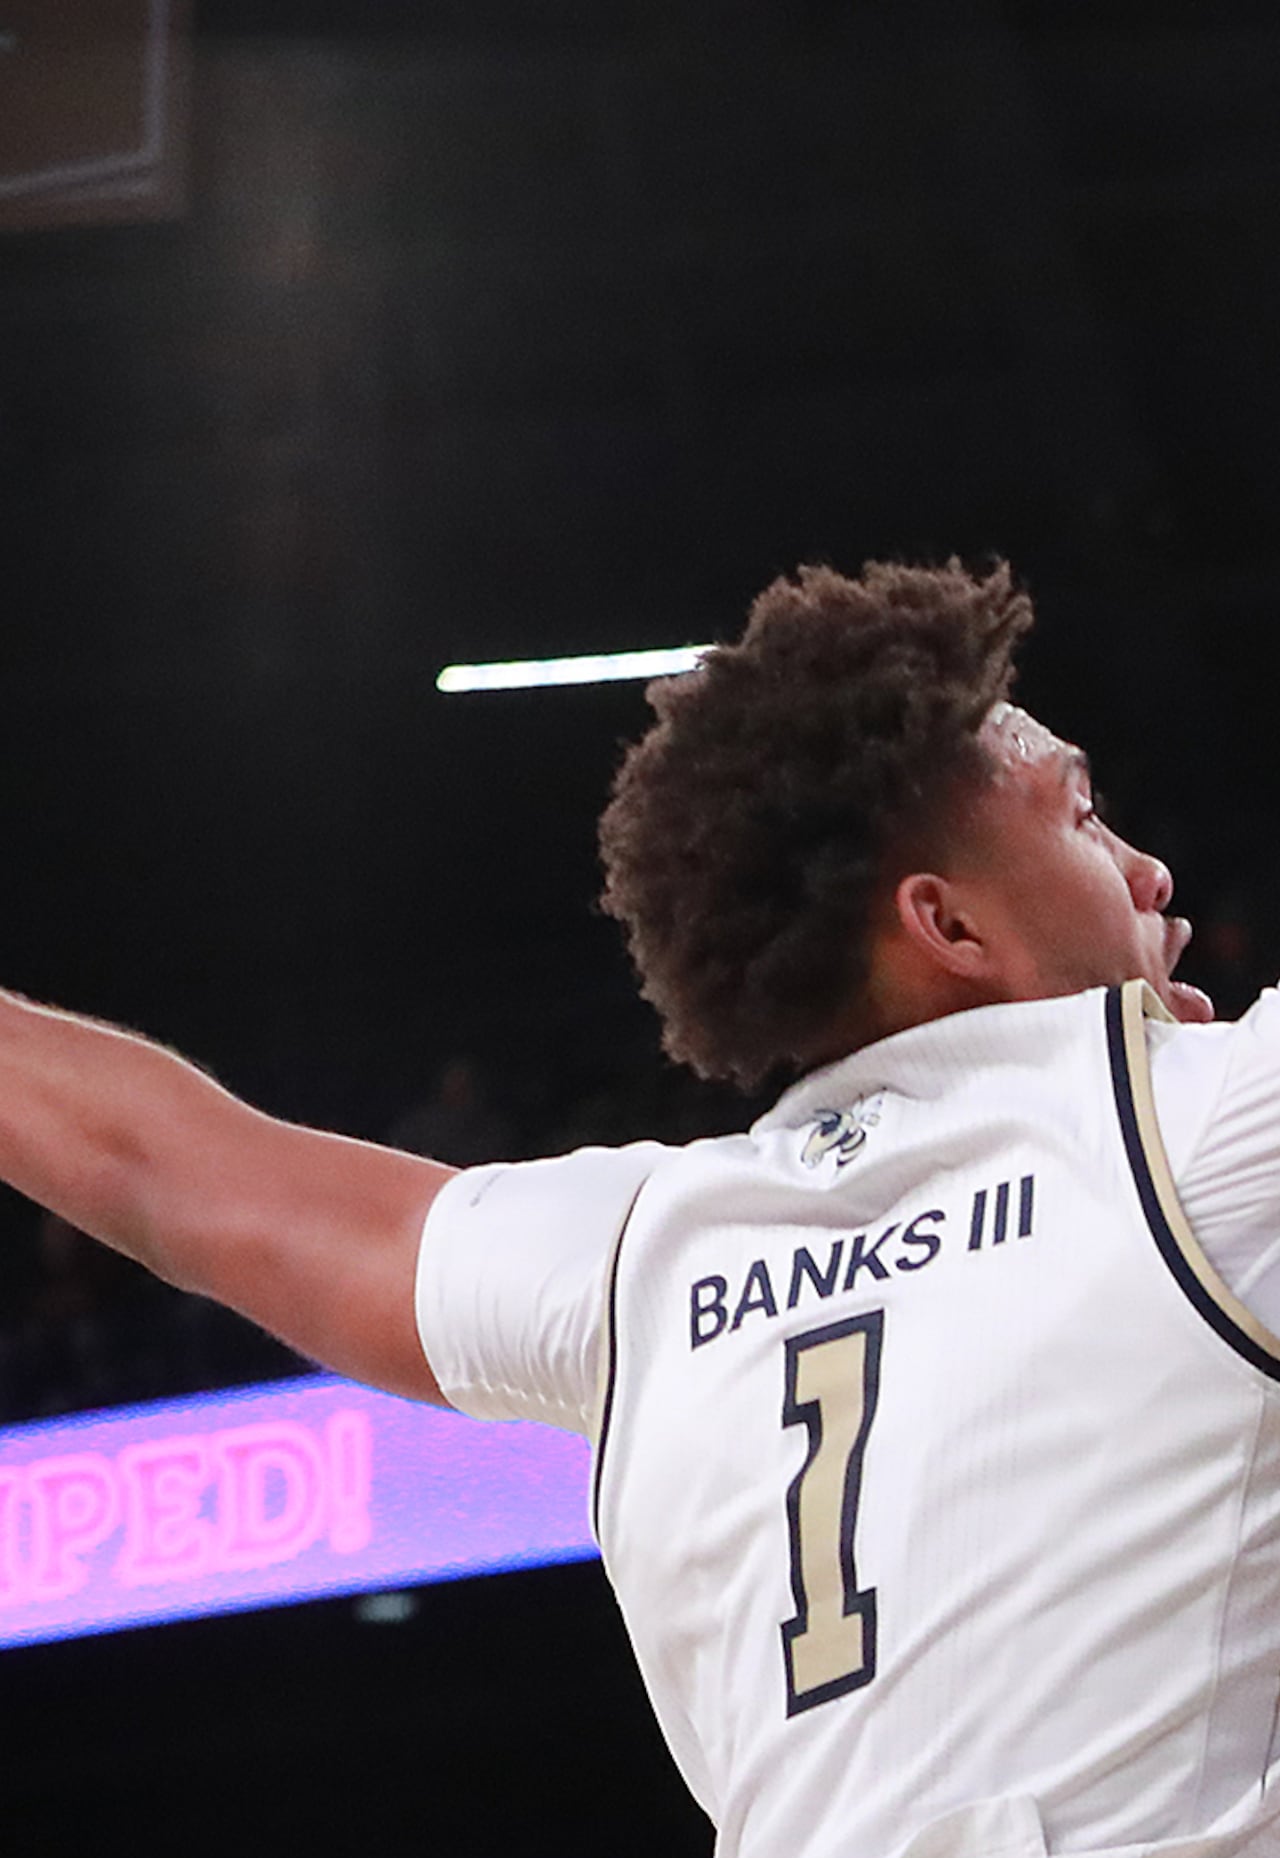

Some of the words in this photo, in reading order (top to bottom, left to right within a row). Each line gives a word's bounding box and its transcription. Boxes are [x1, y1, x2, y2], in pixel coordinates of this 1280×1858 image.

[690, 1208, 946, 1352] BANKS
[966, 1175, 1035, 1253] III
[779, 1308, 886, 1719] 1
